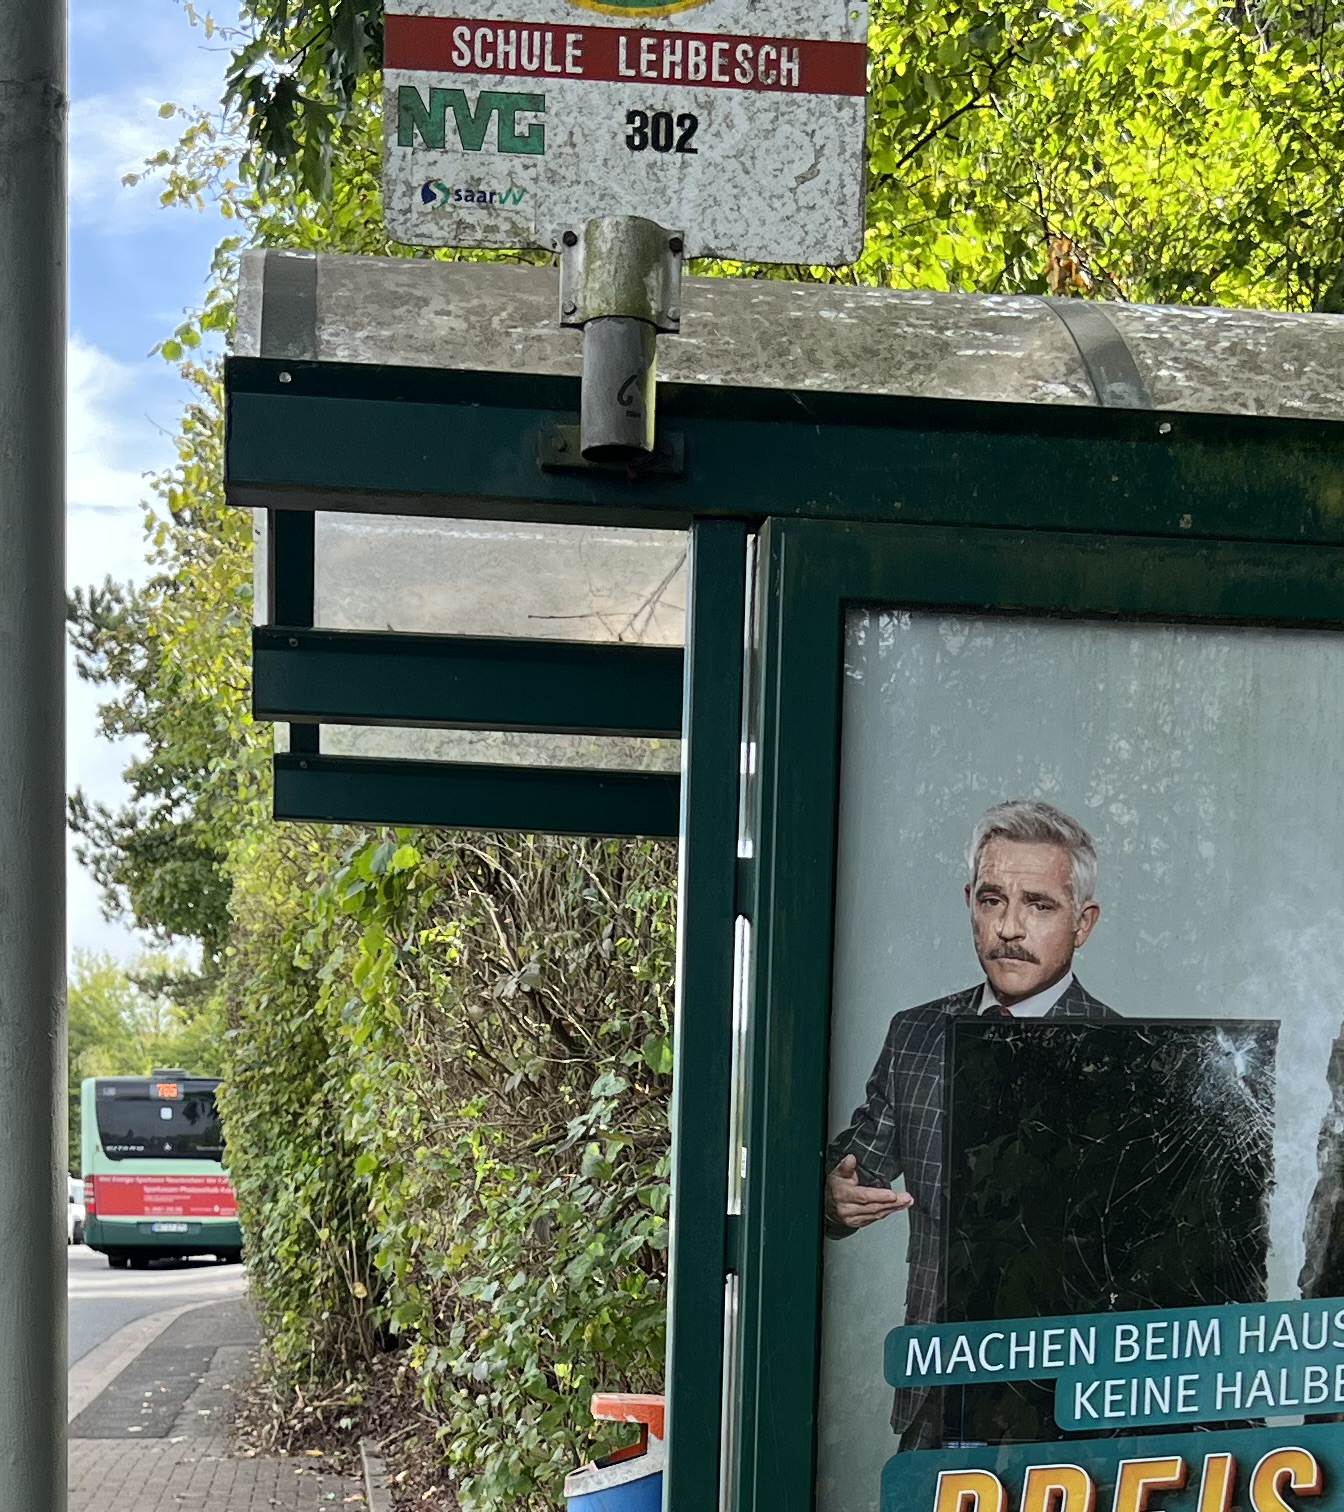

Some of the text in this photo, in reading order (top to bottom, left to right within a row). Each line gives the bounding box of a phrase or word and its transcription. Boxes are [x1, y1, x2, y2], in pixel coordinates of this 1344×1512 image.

[451, 26, 800, 88] SCHULE LEHBESCH
[398, 85, 545, 155] NVG
[625, 110, 698, 155] 302
[904, 1326, 1097, 1376] MACHEN
[1113, 1317, 1223, 1364] BEIM
[1072, 1376, 1199, 1420] KEINE
